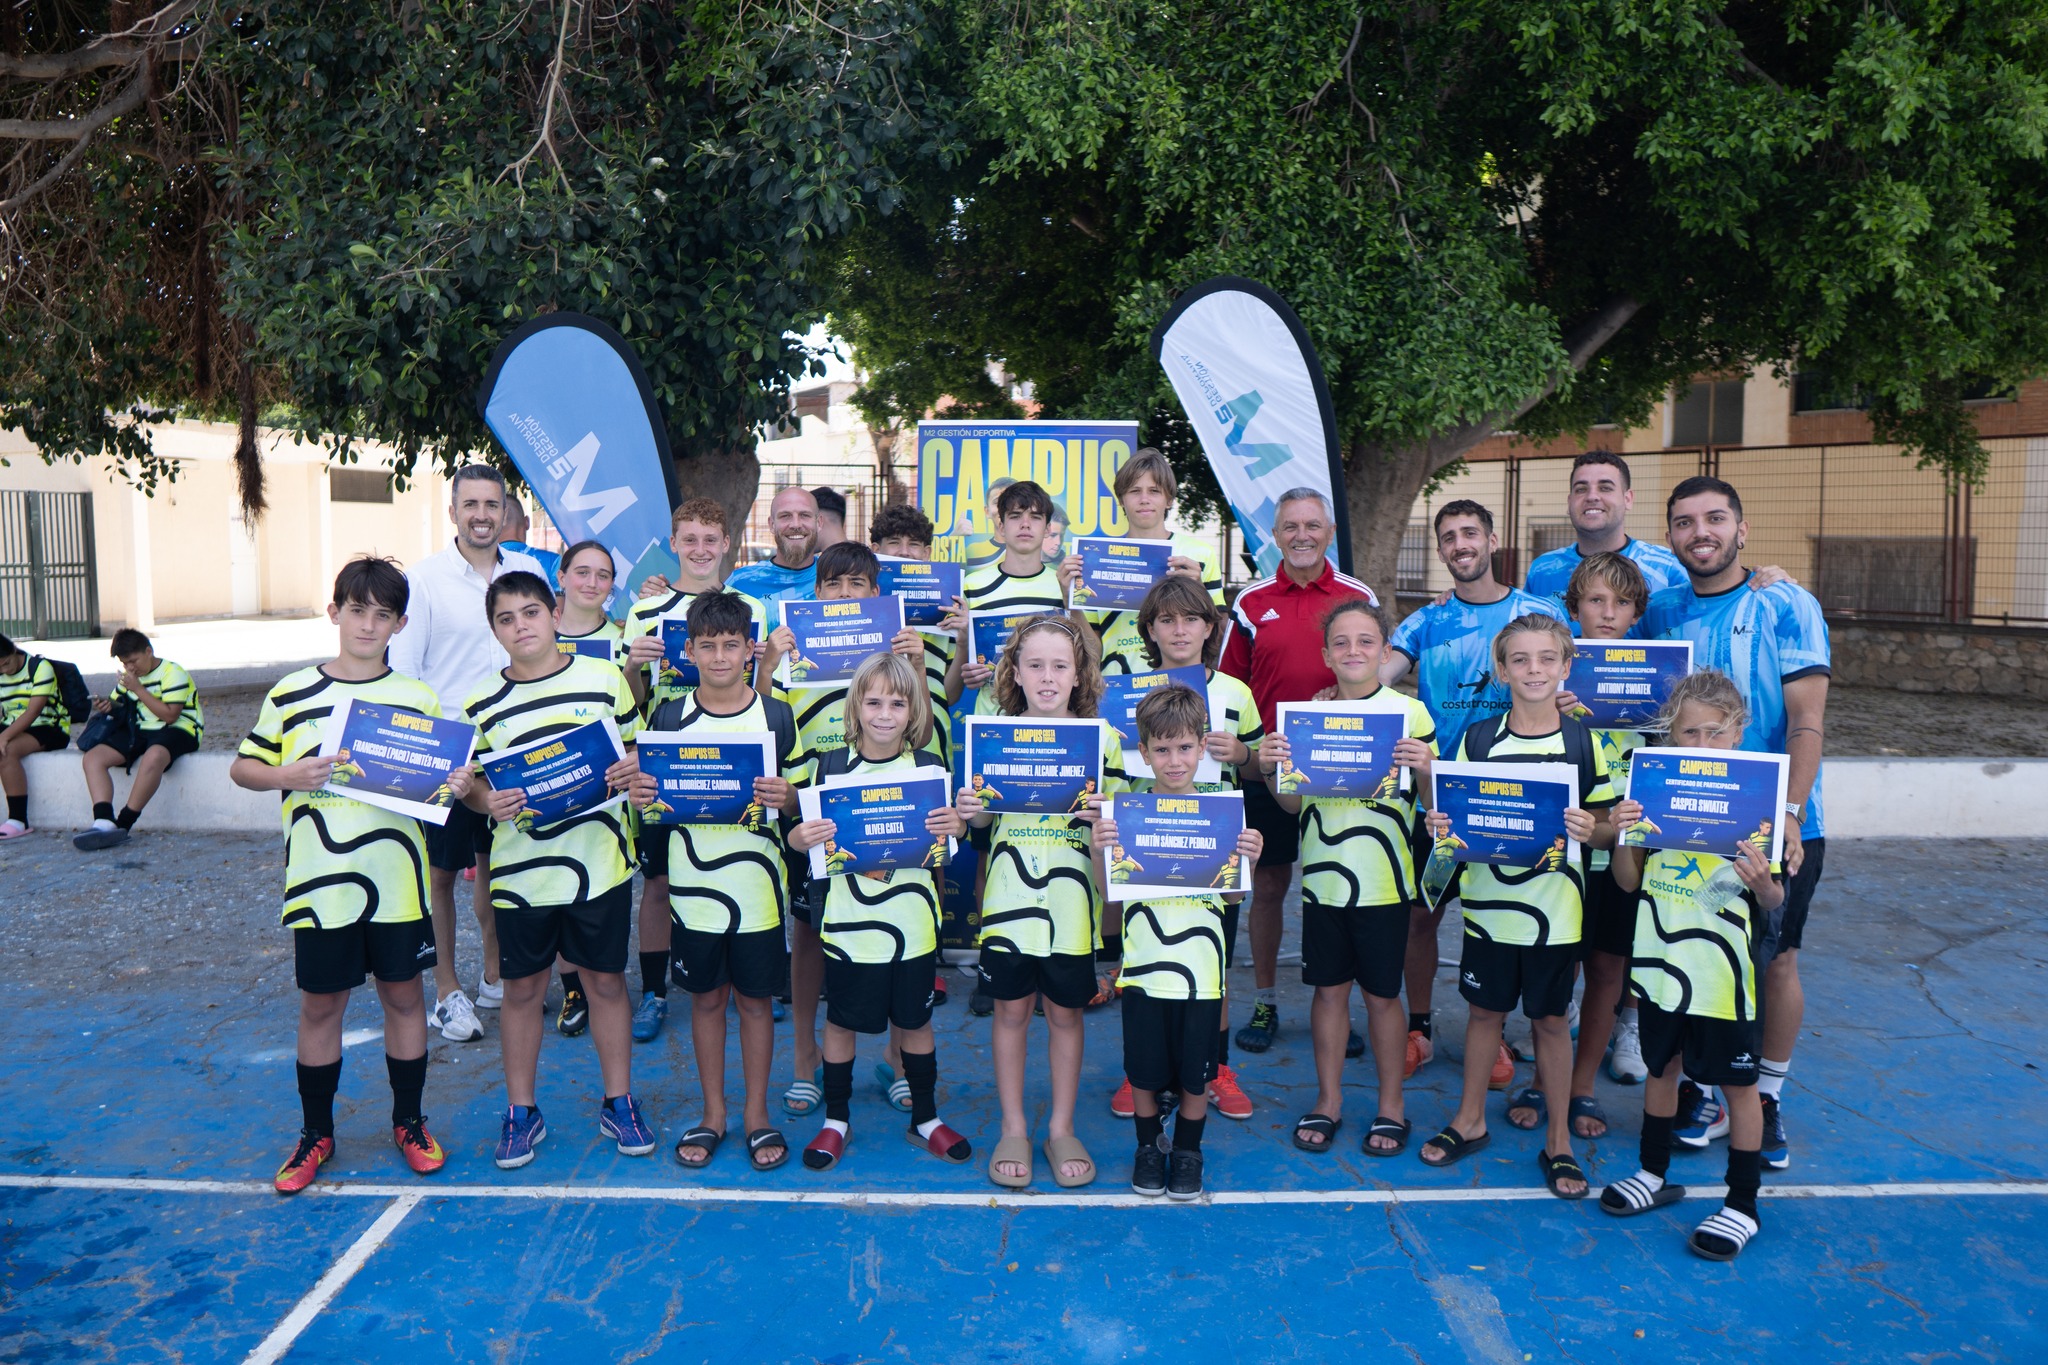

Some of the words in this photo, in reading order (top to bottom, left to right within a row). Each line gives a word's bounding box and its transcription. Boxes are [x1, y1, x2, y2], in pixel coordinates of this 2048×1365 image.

[931, 536, 967, 562] OSTA
[823, 604, 850, 617] CAMPUS
[806, 637, 830, 648] GONZALO
[831, 634, 858, 647] MARTÍNEZ
[858, 632, 883, 644] LORENZO
[1605, 649, 1634, 662] CAMPUS
[1132, 675, 1158, 689] CAMPUS
[1597, 683, 1625, 694] ANTHONY
[1626, 683, 1651, 695] SWIATEK
[1442, 699, 1513, 711] costatropica
[391, 712, 421, 730] CAMPUS
[1324, 717, 1351, 730] CAMPUS
[377, 728, 403, 739] CERTIFICADO
[1014, 729, 1043, 742] CAMPUS
[352, 739, 388, 758] FRANCISCO
[409, 754, 433, 767] CORTÉS
[431, 756, 452, 771] PRATS
[524, 747, 555, 765] CAMPUS
[679, 748, 708, 759] CAMPUS
[1311, 749, 1330, 761] AARÓN
[522, 765, 547, 778] CERTIFICADO
[983, 764, 1008, 775] ANTONIO
[1010, 764, 1033, 776] MANUEL
[1680, 760, 1713, 776] CAMPUS
[526, 781, 551, 796] MARTÍN
[548, 772, 575, 790] MORENO
[572, 764, 592, 781] REYES
[680, 777, 711, 790] RODRÍGUEZ
[712, 779, 741, 791] CARMONA
[1665, 779, 1696, 787] CERTIFICADO
[862, 788, 890, 803] CAMPUS
[1480, 781, 1510, 796] CAMPUS
[1157, 798, 1186, 813] CAMPUS
[1468, 798, 1495, 806] CERTIFICADO
[1671, 797, 1698, 812] CASPER
[1698, 798, 1729, 814] SWIATEK
[852, 807, 878, 815] CERTIFICADO
[865, 823, 885, 836] OLIVER
[1468, 814, 1484, 826] HUGO
[1485, 815, 1507, 828] GARCÍA
[1508, 818, 1534, 832] MARTOS
[1008, 826, 1083, 840] costatropical
[1136, 833, 1160, 847] MARTÍN
[1160, 834, 1188, 848] SÁNCHEZ
[1189, 837, 1216, 850] PEDRAZA
[1649, 879, 1693, 897] costatro
